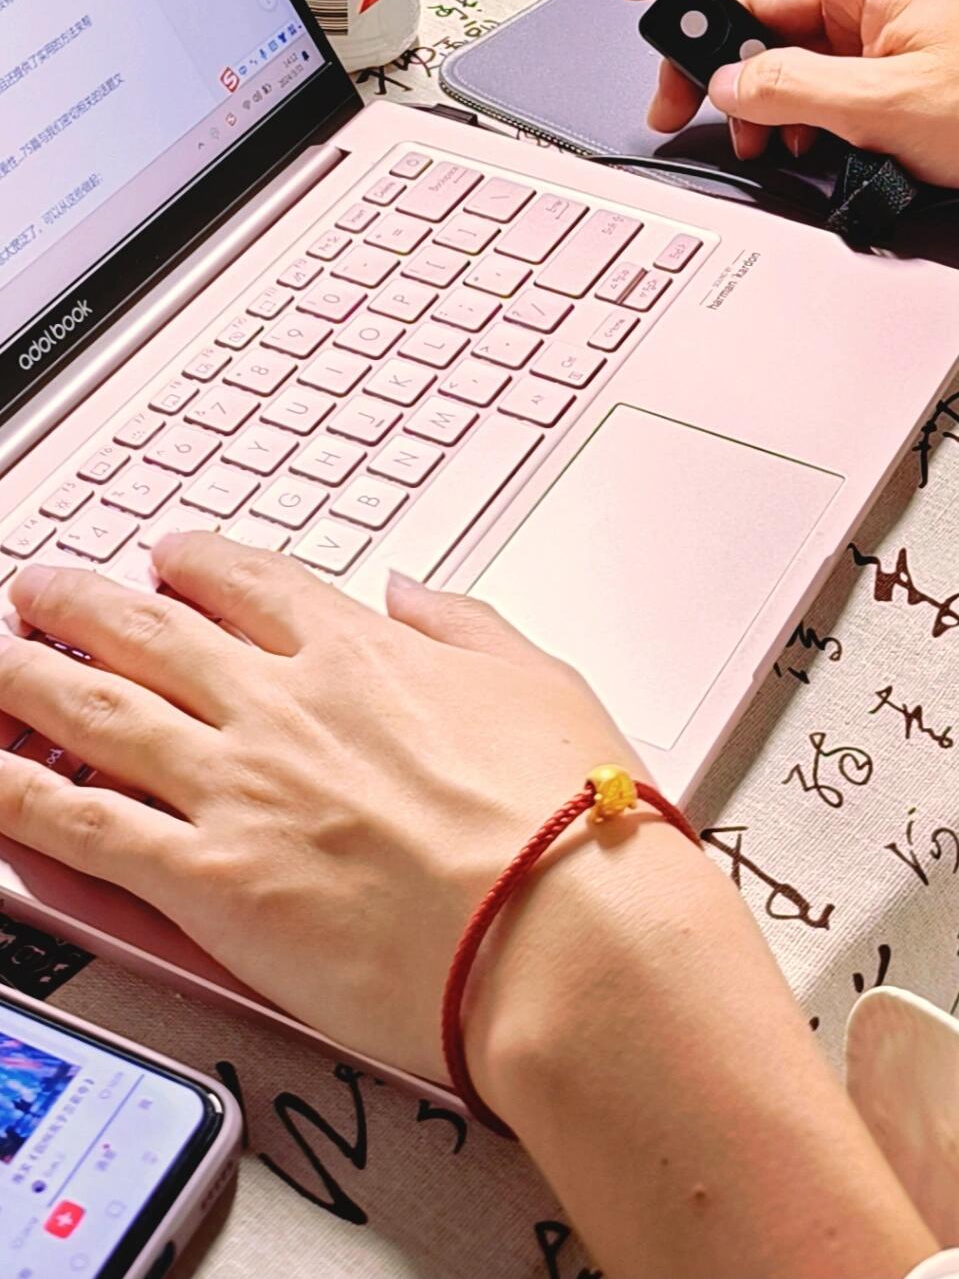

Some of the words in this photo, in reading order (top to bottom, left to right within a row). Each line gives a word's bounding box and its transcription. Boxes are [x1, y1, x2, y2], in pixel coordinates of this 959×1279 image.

[388, 373, 413, 389] K
[286, 401, 310, 416] U
[429, 410, 457, 429] M
[247, 439, 270, 454] Y
[314, 450, 342, 467] H
[393, 451, 419, 468] N
[207, 481, 229, 497] T
[278, 491, 302, 508] G
[357, 493, 381, 508] B
[317, 534, 342, 550] V
